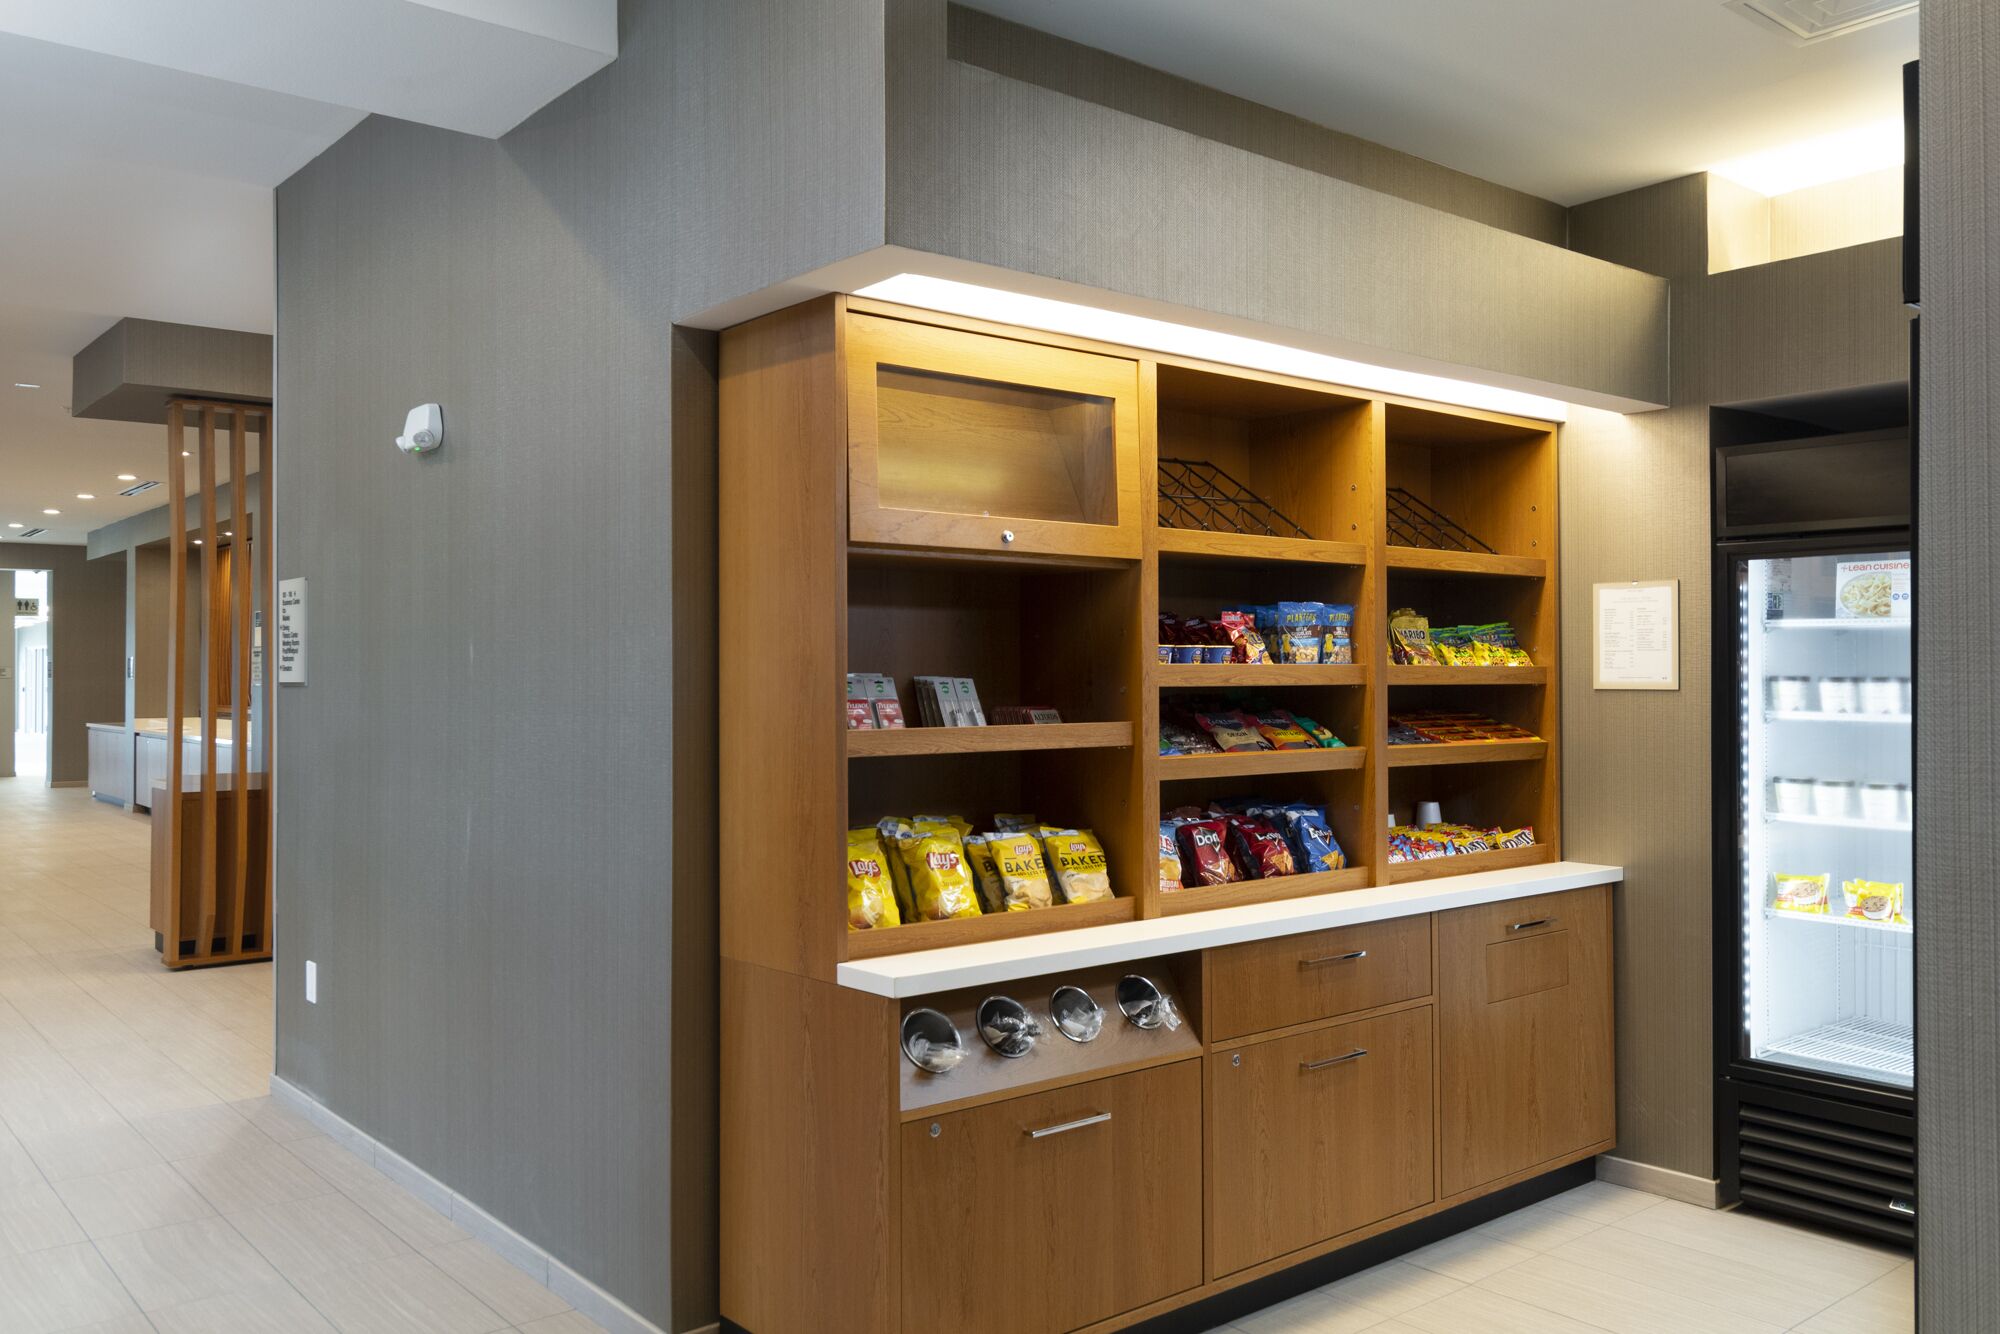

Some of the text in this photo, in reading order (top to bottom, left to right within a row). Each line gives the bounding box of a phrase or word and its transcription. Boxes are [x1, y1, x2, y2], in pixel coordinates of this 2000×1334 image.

[850, 860, 879, 877] Lay's
[928, 851, 958, 870] Lay's
[1004, 857, 1044, 873] BAKE
[1060, 854, 1106, 867] BAKED
